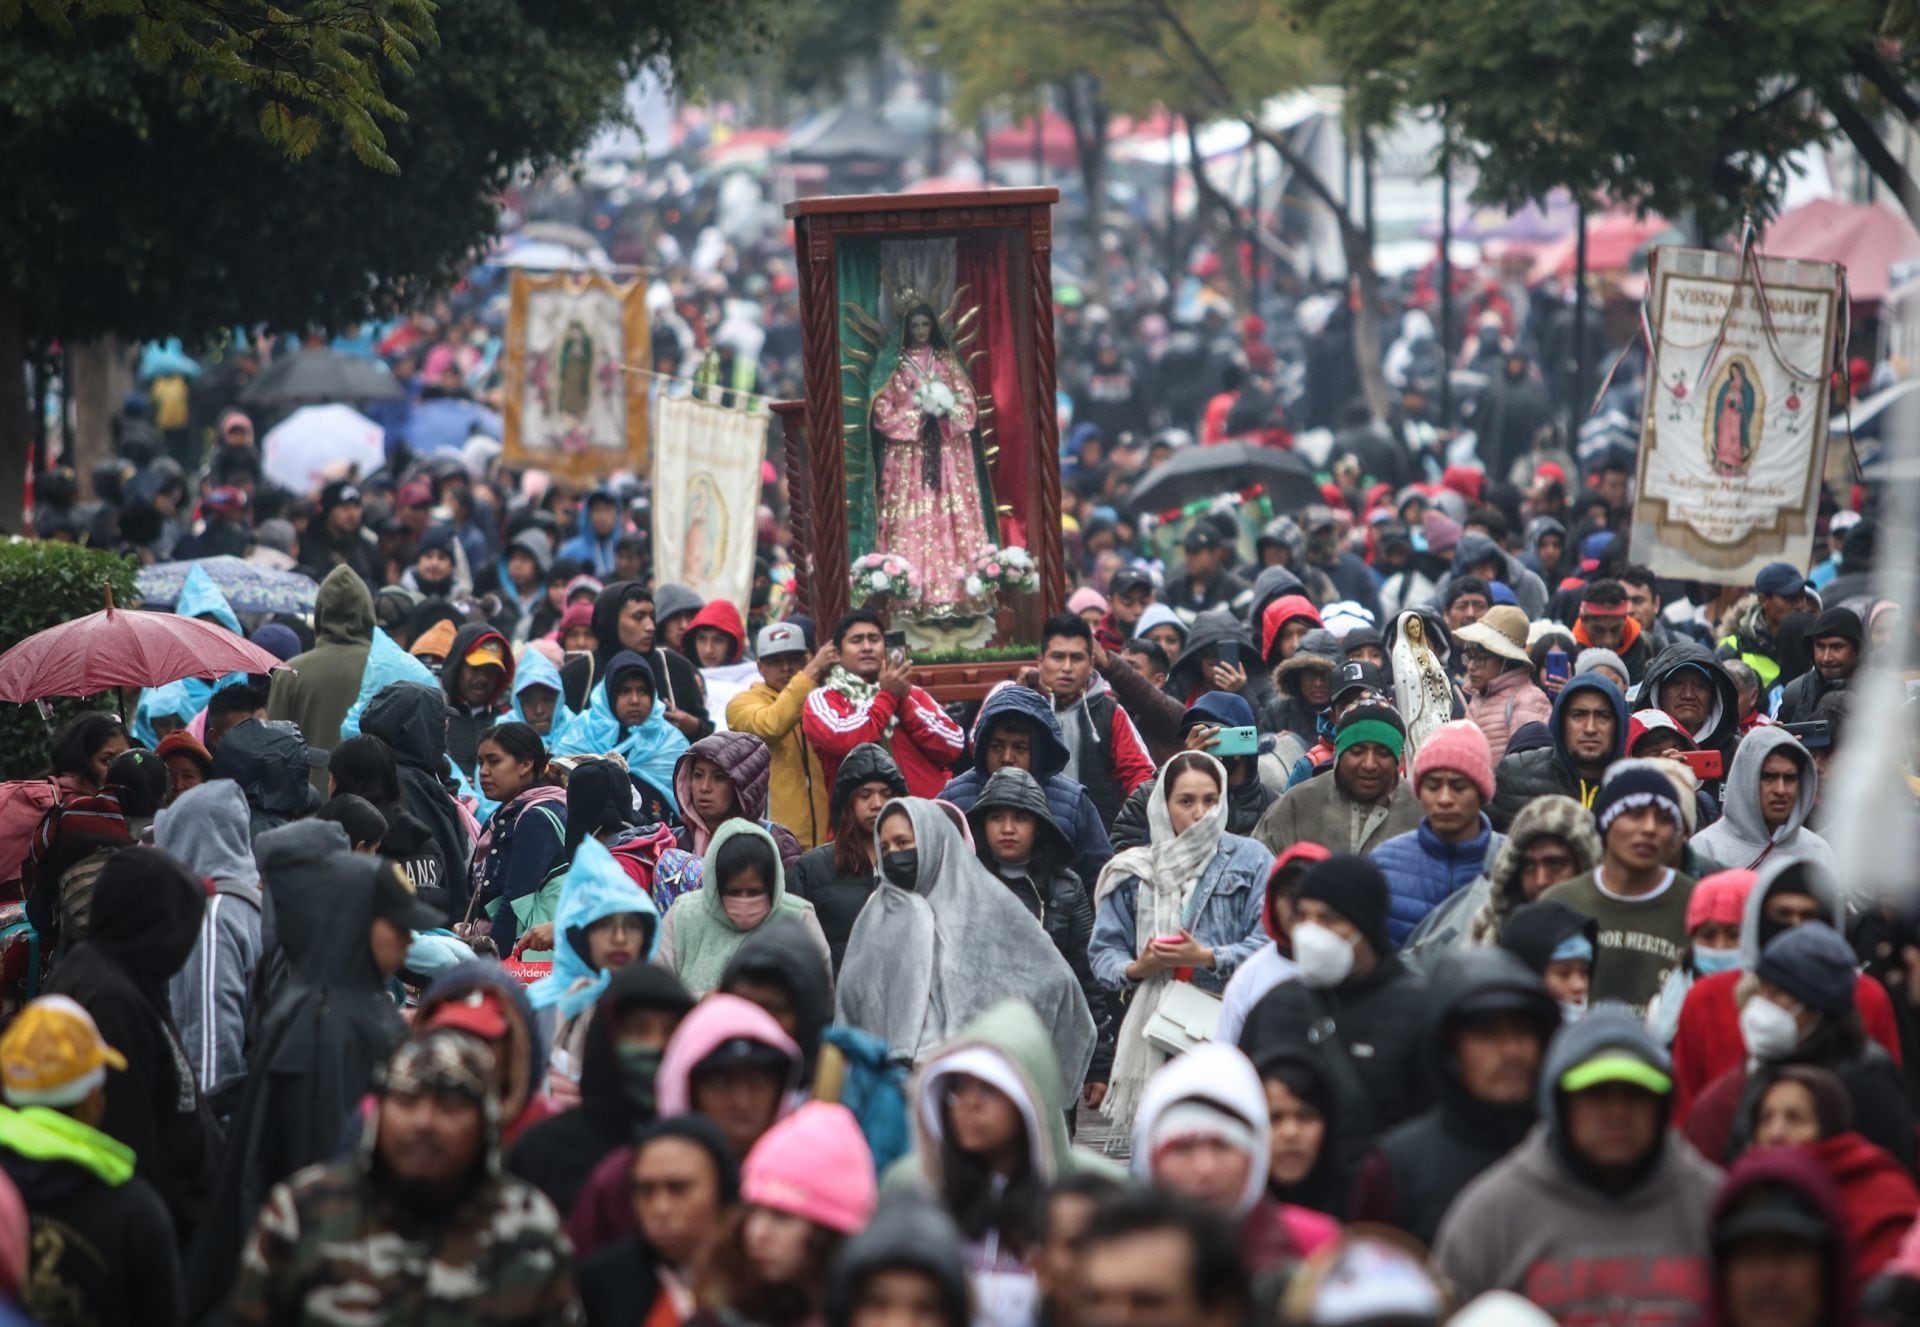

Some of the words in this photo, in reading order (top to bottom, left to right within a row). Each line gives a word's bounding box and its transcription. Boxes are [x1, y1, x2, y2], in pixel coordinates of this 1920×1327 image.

[406, 859, 437, 887] ANS
[1625, 931, 1677, 960] HERITA
[510, 966, 552, 978] ovidenc
